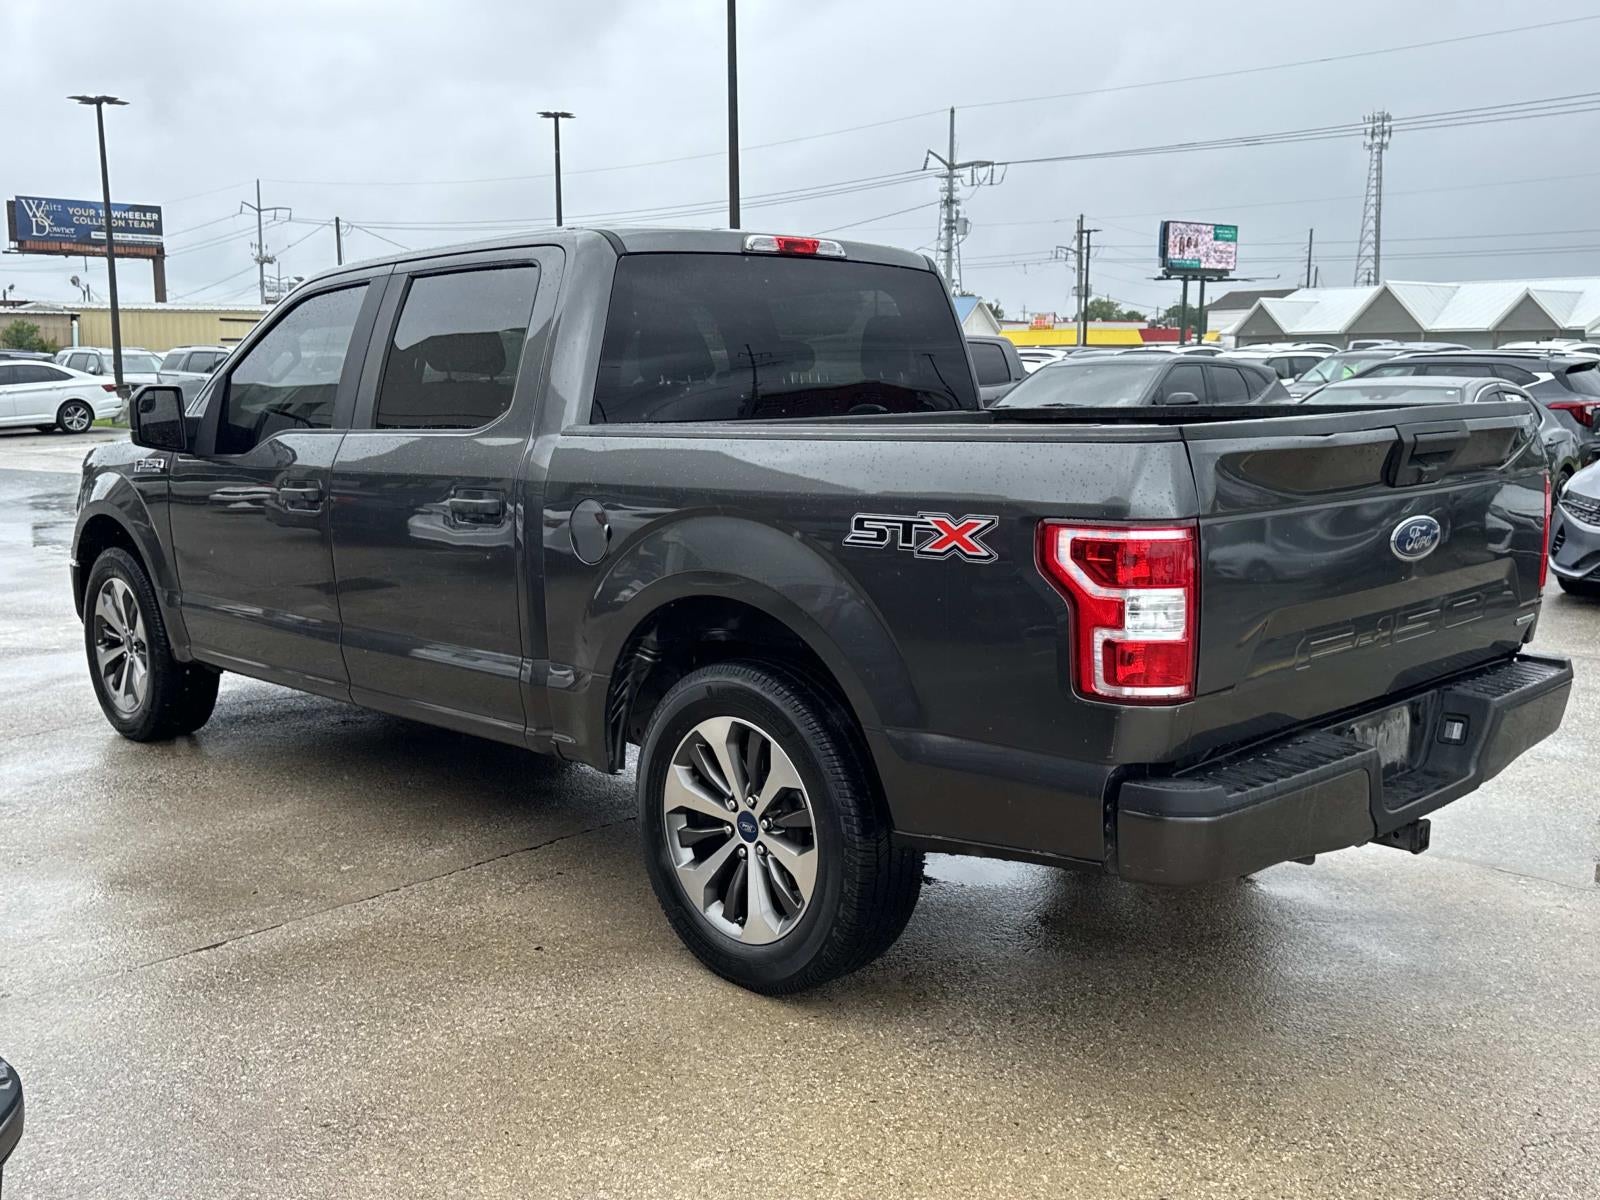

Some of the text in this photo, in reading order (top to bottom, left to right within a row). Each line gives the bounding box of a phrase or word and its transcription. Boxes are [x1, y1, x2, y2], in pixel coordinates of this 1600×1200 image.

[67, 207, 96, 217] YOUR
[111, 210, 159, 221] WHEELER
[73, 216, 155, 229] COLLISON TEAM
[842, 511, 999, 564] STX
[1405, 524, 1434, 551] Ford
